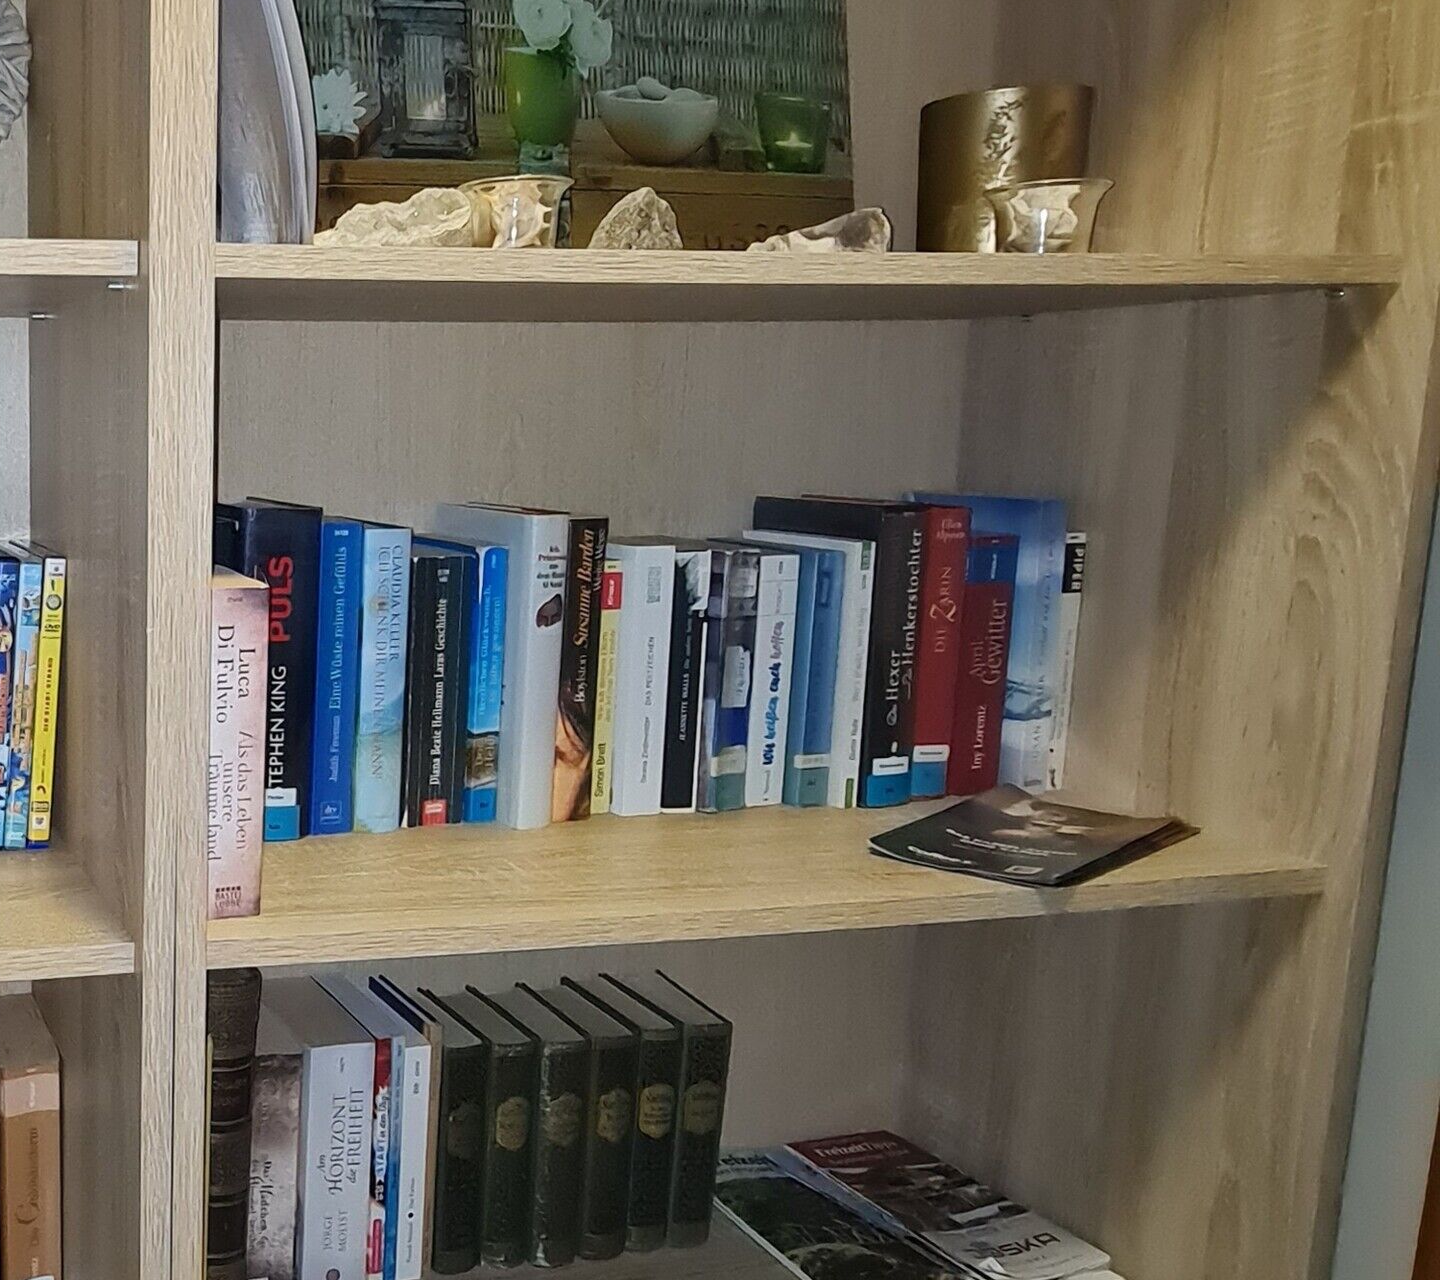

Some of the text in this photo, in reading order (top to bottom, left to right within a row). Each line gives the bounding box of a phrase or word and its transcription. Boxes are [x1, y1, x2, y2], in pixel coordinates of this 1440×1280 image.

[267, 555, 295, 643] PULS
[334, 546, 347, 594] Gefühls
[391, 544, 404, 608] CLAUDIA
[903, 528, 923, 666] Henkerstochter
[929, 565, 956, 623] ZARIN
[334, 597, 345, 637] reinen
[574, 528, 595, 704] Boylston Susanne Barden
[982, 599, 1008, 686] Gewitter
[216, 625, 236, 724] Di Fulvio
[238, 647, 256, 699] Luca
[271, 665, 288, 713] KING
[331, 640, 344, 679] Wüste
[886, 650, 902, 701] Hexer
[969, 640, 984, 679] April
[330, 681, 343, 709] Eine
[429, 597, 448, 786] Diana Beate Hellmann Laras Geschichte
[971, 704, 988, 771] Iny Lorentz
[222, 761, 235, 822] unsere
[235, 730, 255, 849] Als das Leben
[595, 741, 607, 798] Simon Brett
[328, 1093, 347, 1196] HORIZONT
[346, 1087, 364, 1184] die FREIHEIT
[322, 1216, 333, 1251] JORGE
[338, 1210, 348, 1252] MOLIST
